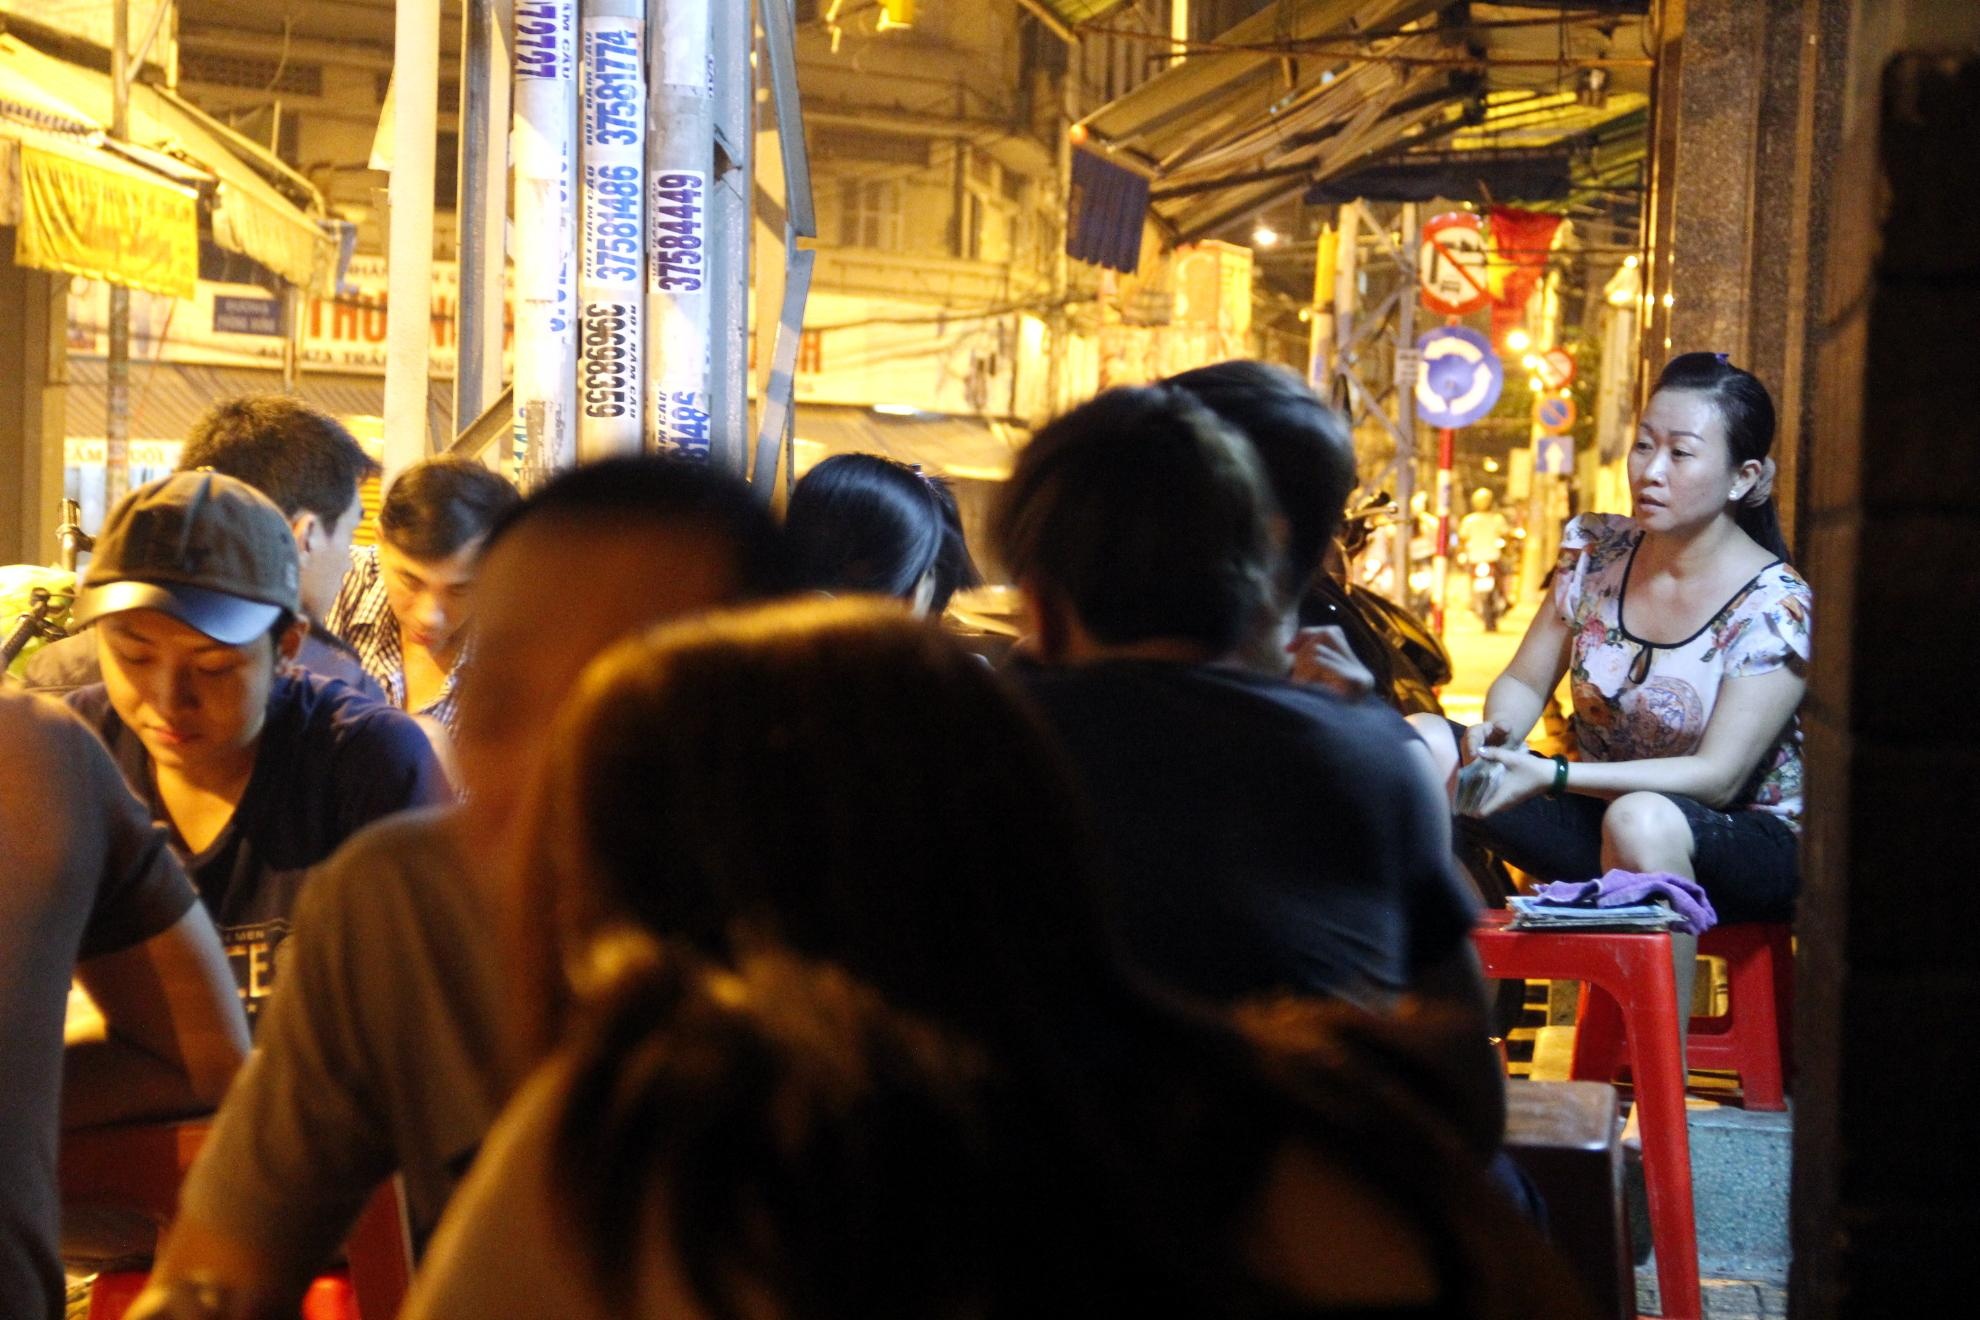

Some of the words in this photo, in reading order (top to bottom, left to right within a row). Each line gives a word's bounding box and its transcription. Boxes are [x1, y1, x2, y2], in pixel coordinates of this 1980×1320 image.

[514, 0, 556, 78] 72727
[595, 30, 637, 146] 37581774
[596, 165, 638, 281] 37581486
[657, 174, 702, 291] 37584449
[585, 303, 626, 418] 39698359
